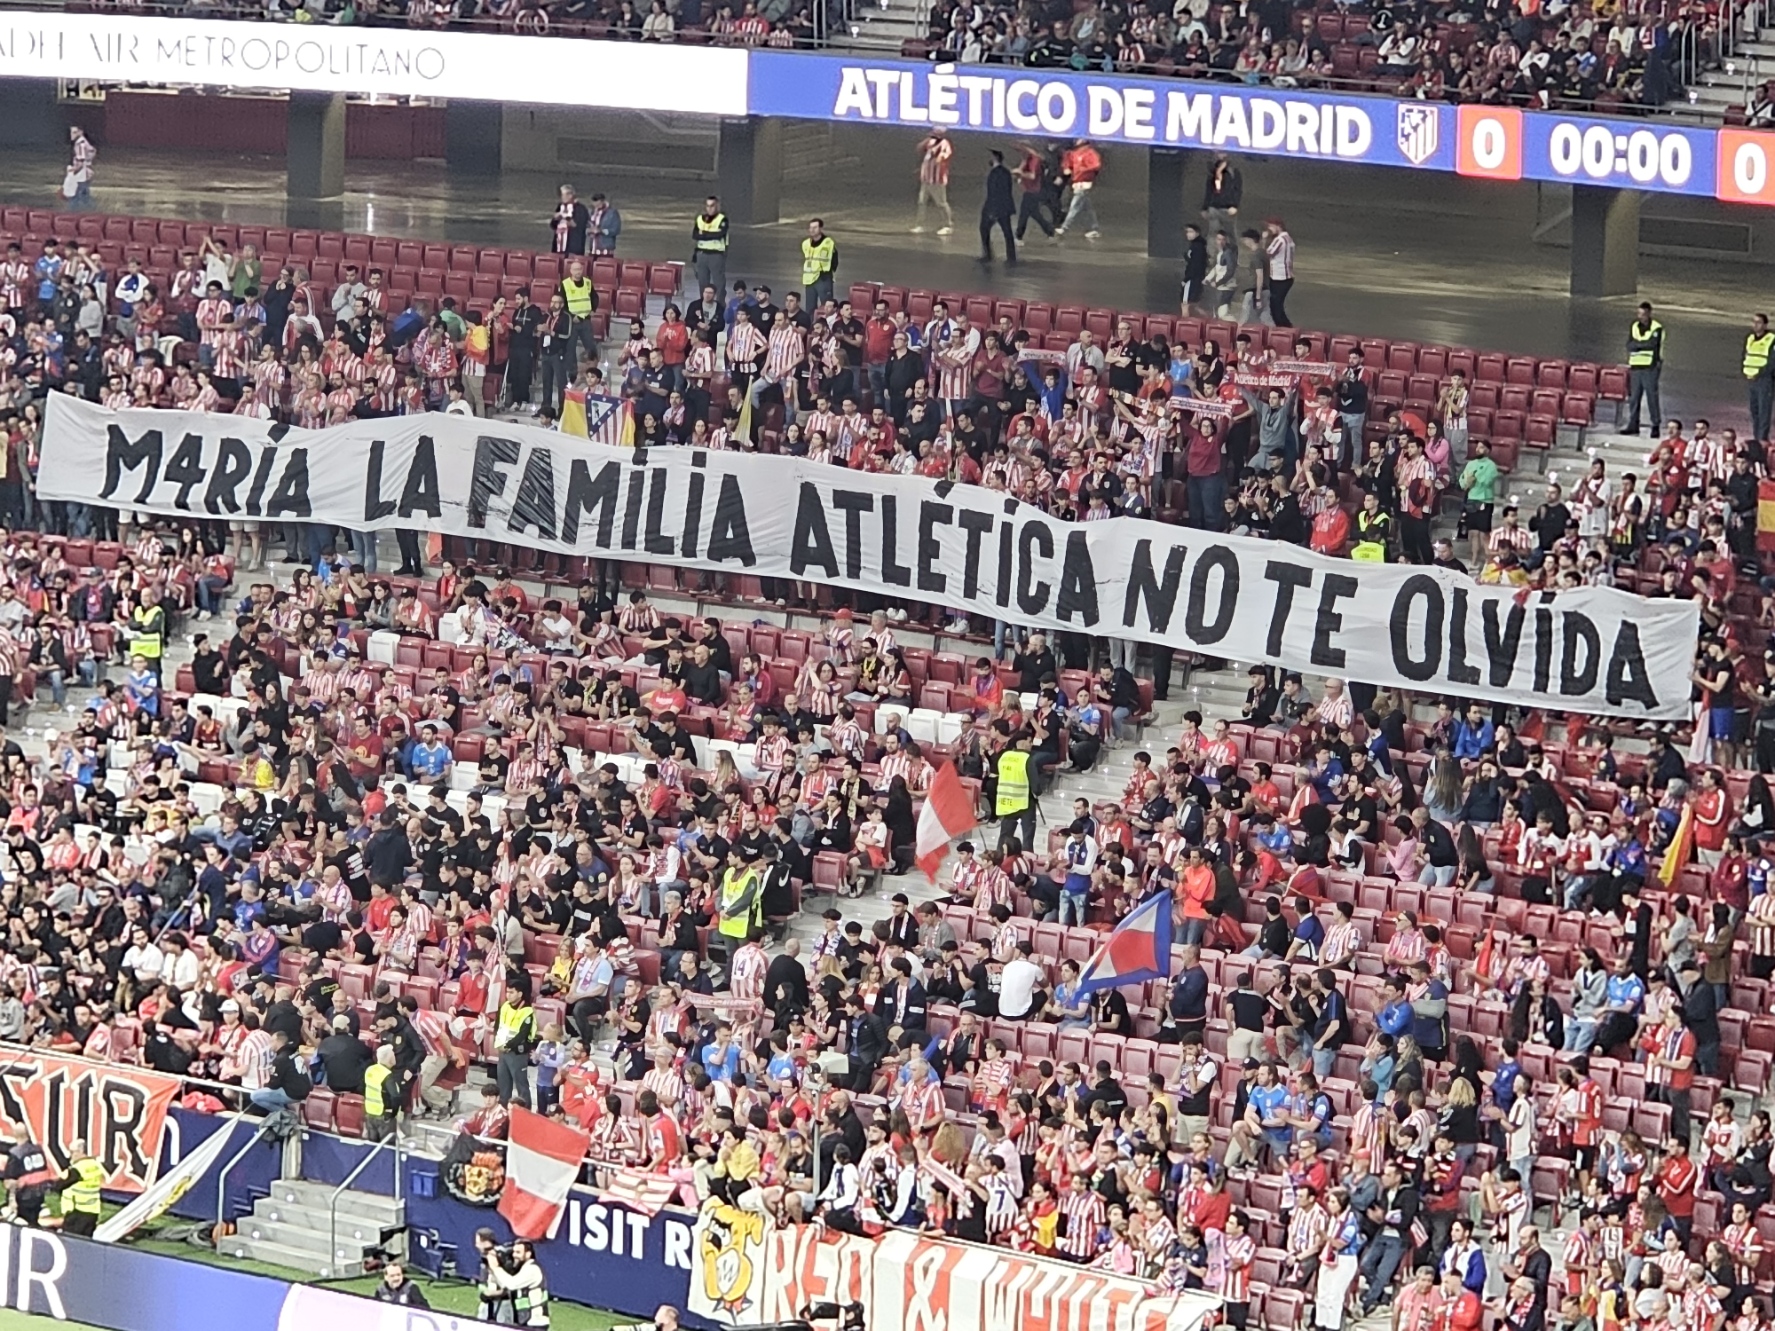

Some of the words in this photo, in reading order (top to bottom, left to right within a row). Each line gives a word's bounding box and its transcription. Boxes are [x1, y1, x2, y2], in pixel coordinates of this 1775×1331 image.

[157, 35, 445, 79] METROPOLITANO
[834, 62, 1077, 132] ATLÉTICO
[1088, 85, 1156, 139] DE
[1166, 91, 1373, 157] MADRID
[1471, 119, 1505, 169] 0
[1549, 123, 1692, 185] 00:00
[1734, 143, 1766, 194] 0
[365, 435, 442, 521] LA
[1122, 538, 1240, 646] NO
[1264, 559, 1359, 668] TE
[734, 958, 747, 976] 14
[995, 1190, 1006, 1212] 7
